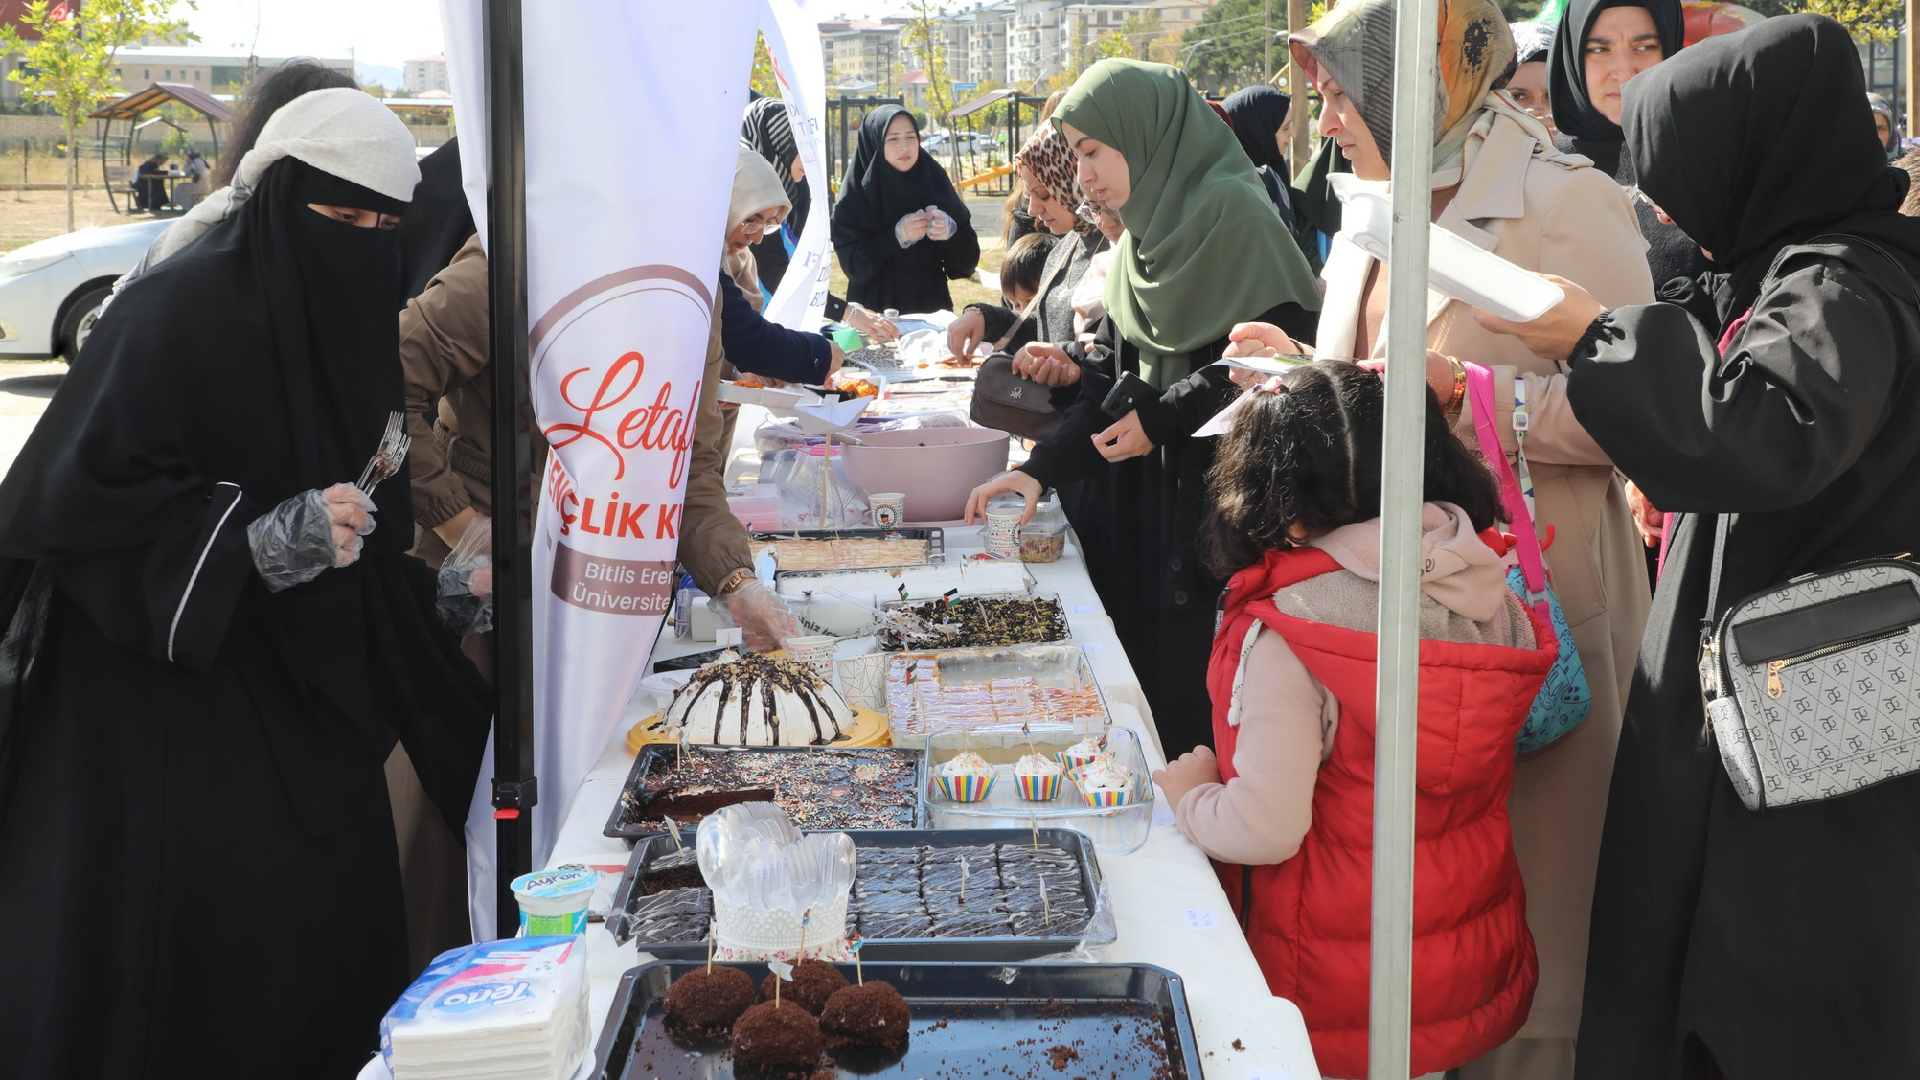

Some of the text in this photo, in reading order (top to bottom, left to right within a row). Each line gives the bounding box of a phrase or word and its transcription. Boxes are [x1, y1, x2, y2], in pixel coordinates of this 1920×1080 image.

[584, 562, 636, 585] Bitlis
[526, 872, 583, 891] Ayran
[443, 981, 531, 1007] Teno
